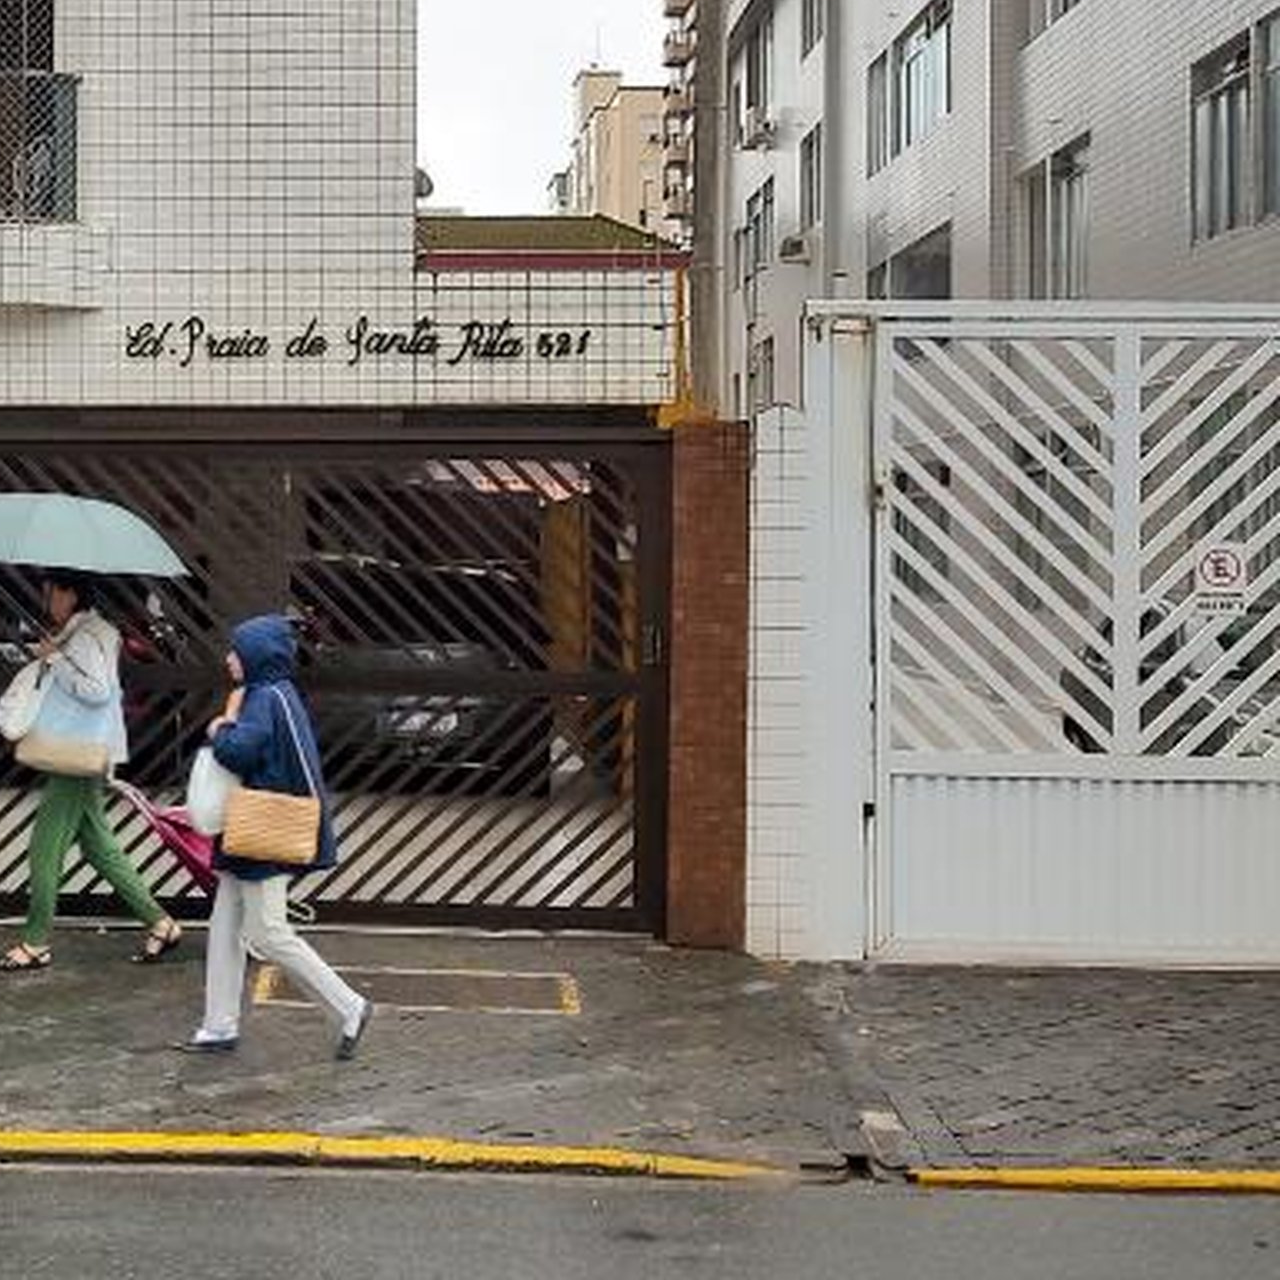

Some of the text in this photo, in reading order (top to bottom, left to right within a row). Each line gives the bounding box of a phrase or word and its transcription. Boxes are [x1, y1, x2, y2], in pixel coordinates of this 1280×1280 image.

[126, 316, 591, 367] Ed. Praia de Santa Rita 521
